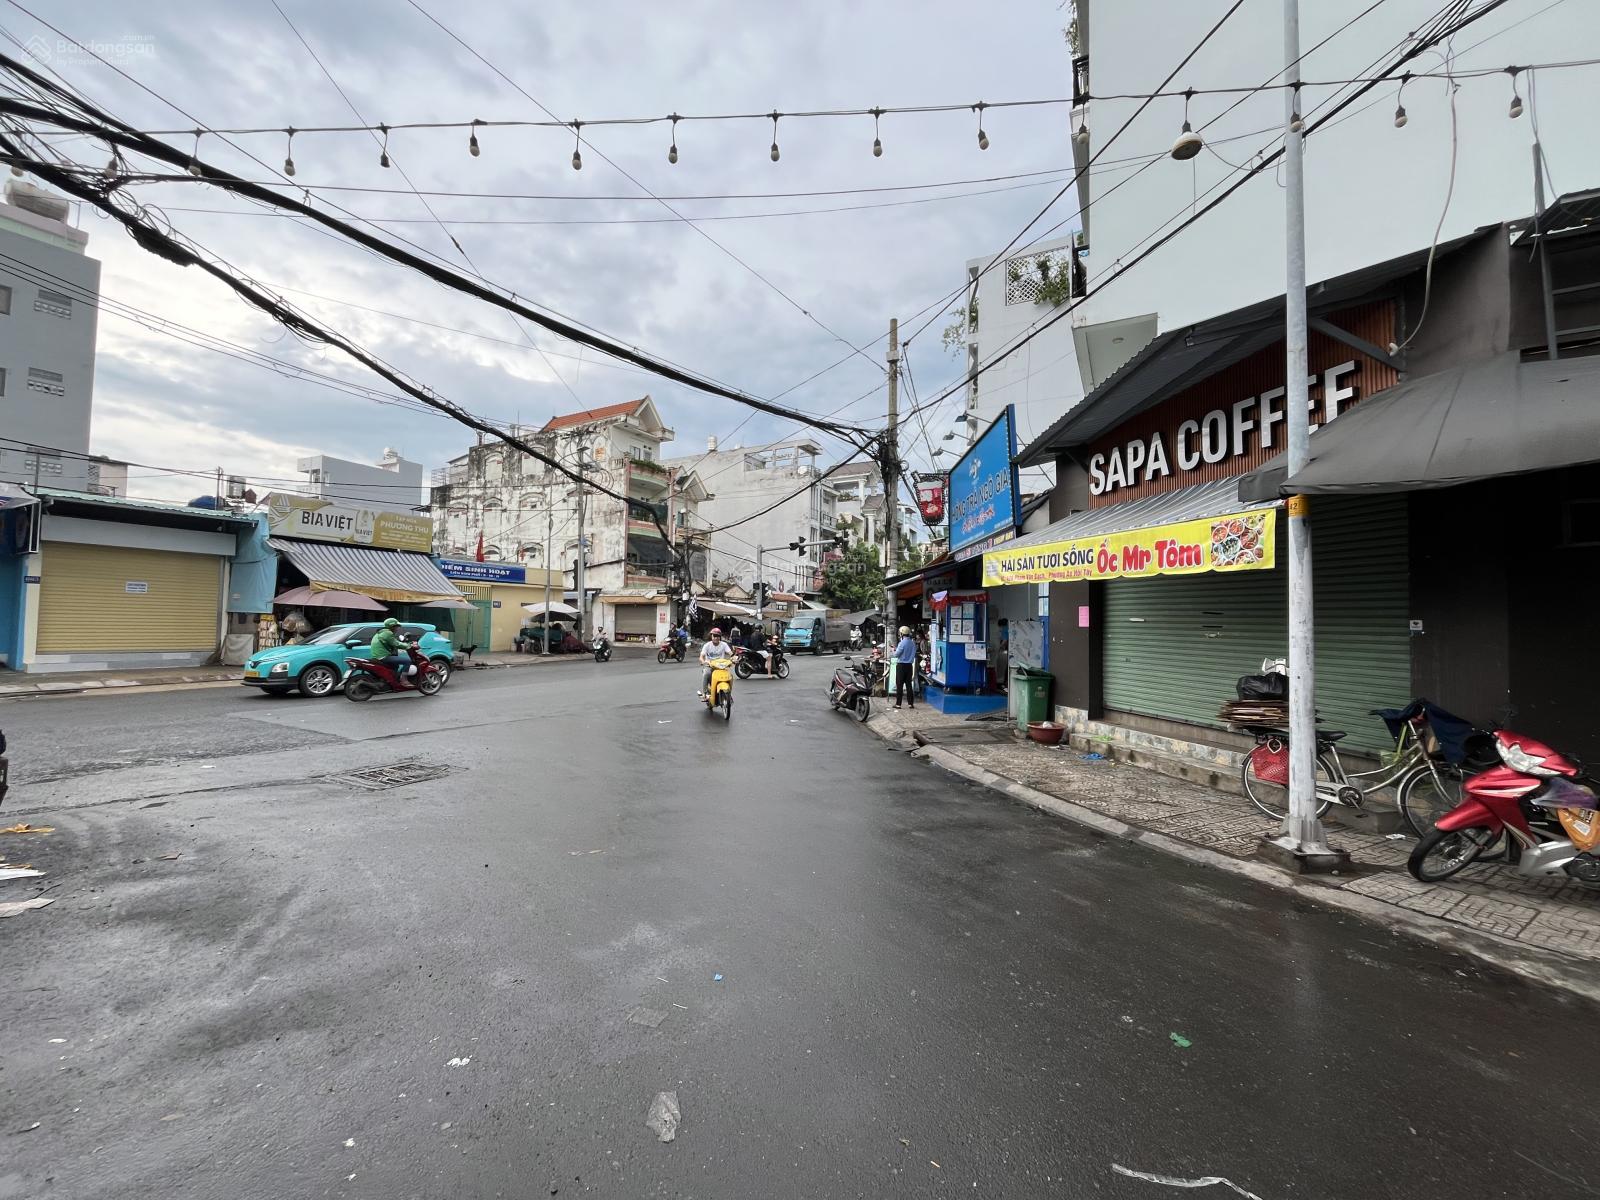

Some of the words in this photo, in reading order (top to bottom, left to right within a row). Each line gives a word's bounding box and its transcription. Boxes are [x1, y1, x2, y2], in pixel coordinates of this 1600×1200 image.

[1089, 431, 1171, 496] SAPA
[301, 510, 323, 527] BIA
[325, 513, 353, 531] VIỆT
[1017, 553, 1035, 571] SẢN
[1036, 553, 1061, 569] TƯƠI
[1062, 543, 1094, 566] SỐNG
[1097, 537, 1118, 574] Ốc
[1122, 546, 1151, 572] Mr
[1154, 537, 1202, 569] Tôm
